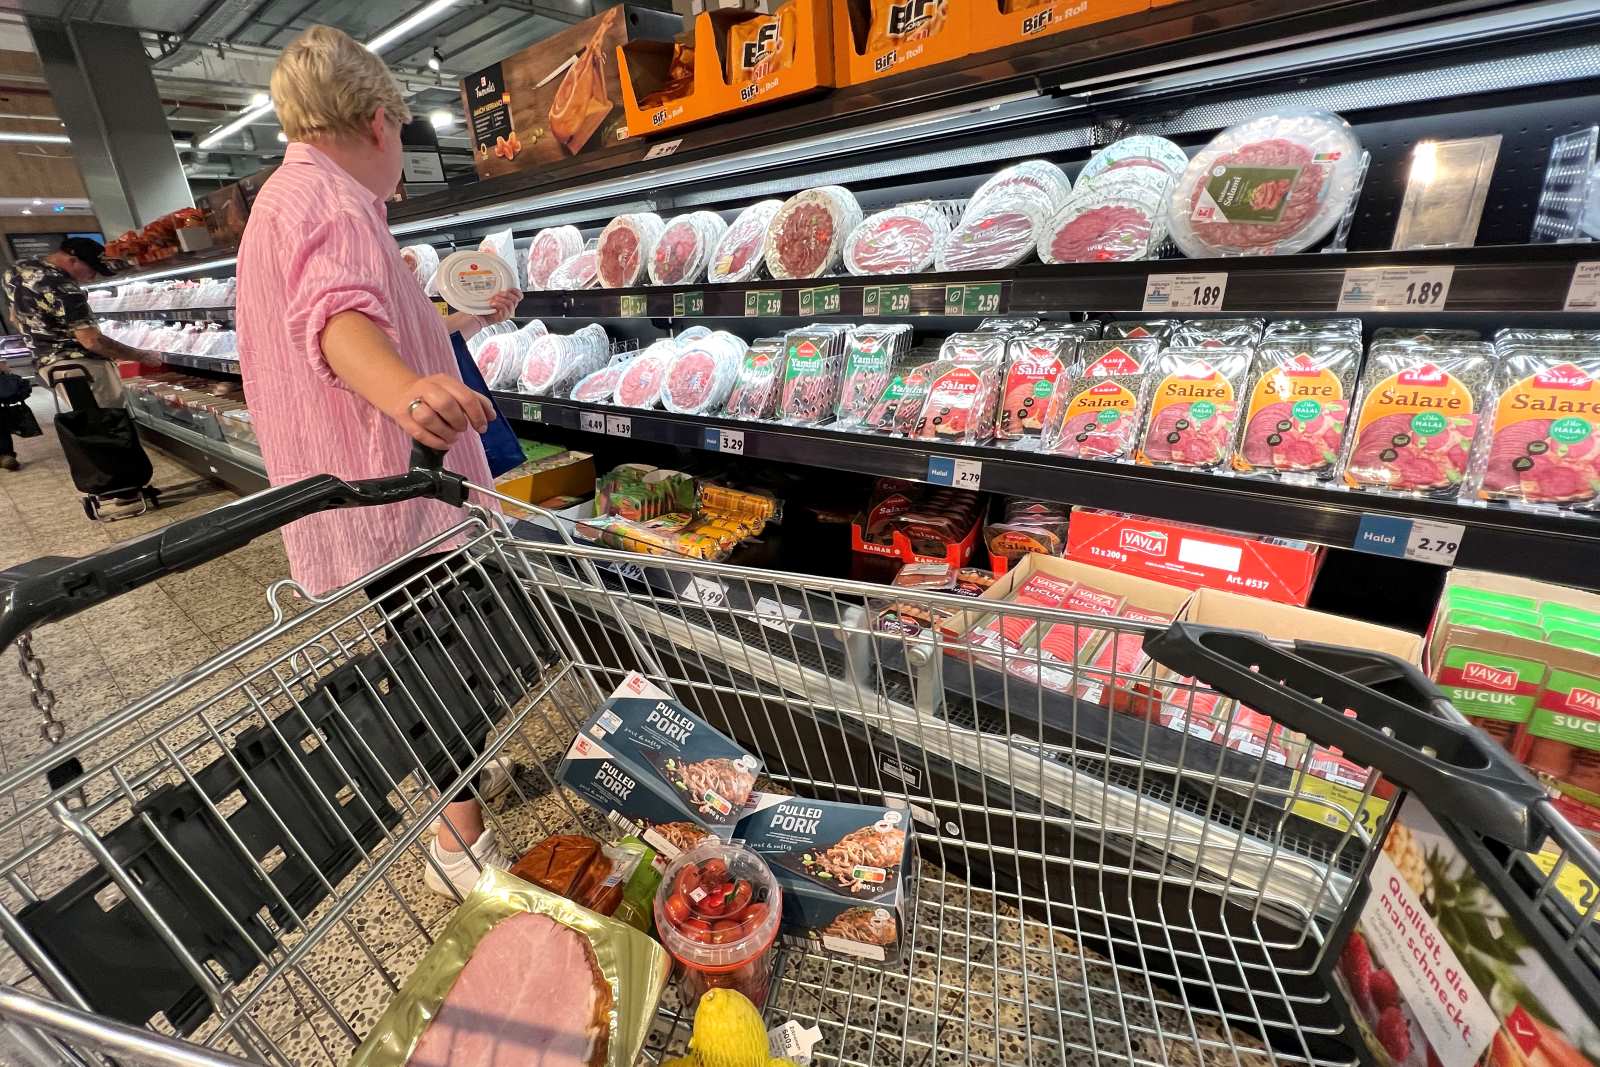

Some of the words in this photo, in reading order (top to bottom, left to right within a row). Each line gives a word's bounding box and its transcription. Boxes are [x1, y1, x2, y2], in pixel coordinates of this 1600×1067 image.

[1023, 8, 1053, 33] BiFi
[1065, 1, 1088, 18] Roll
[875, 50, 897, 71] BiFi
[905, 44, 924, 60] Roll
[740, 84, 759, 100] BiFi
[653, 109, 667, 125] BiFi
[1223, 176, 1242, 207] Salami
[1193, 286, 1220, 306] 1.89
[1406, 281, 1443, 305] 1.89
[767, 299, 781, 313] 2.59
[824, 294, 840, 310] 2.59
[891, 294, 910, 311] 2.59
[978, 294, 1000, 311] 2.59
[791, 358, 820, 369] Yamini
[853, 354, 884, 364] Yamini
[1017, 364, 1057, 375] Salare
[939, 380, 977, 391] Salare
[1166, 383, 1225, 398] Salare
[1264, 381, 1332, 396] Slare
[1077, 397, 1129, 408] Salare
[1378, 390, 1461, 409] Salare
[1511, 393, 1600, 414] Salare
[588, 419, 603, 430] 4.49
[616, 424, 631, 434] 1.39
[1415, 420, 1443, 428] HALAL
[1554, 427, 1586, 435] HALAL
[723, 437, 743, 451] 3.29
[961, 472, 980, 482] 2.79
[1123, 532, 1163, 553] YAYLA
[1363, 531, 1396, 544] Halal
[863, 544, 891, 554] KAMAR
[1091, 546, 1100, 555] 12
[1101, 549, 1107, 557] x
[1106, 550, 1120, 560] 200
[1121, 554, 1127, 562] g
[1418, 538, 1458, 554] 2.79
[1038, 579, 1066, 593] YAYLA
[1226, 574, 1244, 586] Art.
[1245, 577, 1270, 591] #537
[1024, 585, 1062, 601] SUCUK
[1080, 591, 1111, 606] YAYLA
[1069, 598, 1110, 617] SUCUK
[1469, 666, 1513, 687] YAYLA
[1453, 689, 1516, 706] SUCUK
[655, 701, 696, 732] PULLED
[646, 710, 693, 745] PORK
[601, 761, 636, 790] PULLED
[594, 769, 633, 801] PORK
[777, 804, 823, 819] PULLED
[769, 814, 821, 835] PORK
[1388, 875, 1442, 967] Qualität,
[1445, 967, 1469, 1005] die
[1380, 893, 1407, 937] man
[1406, 936, 1473, 1049] schmeckt.
